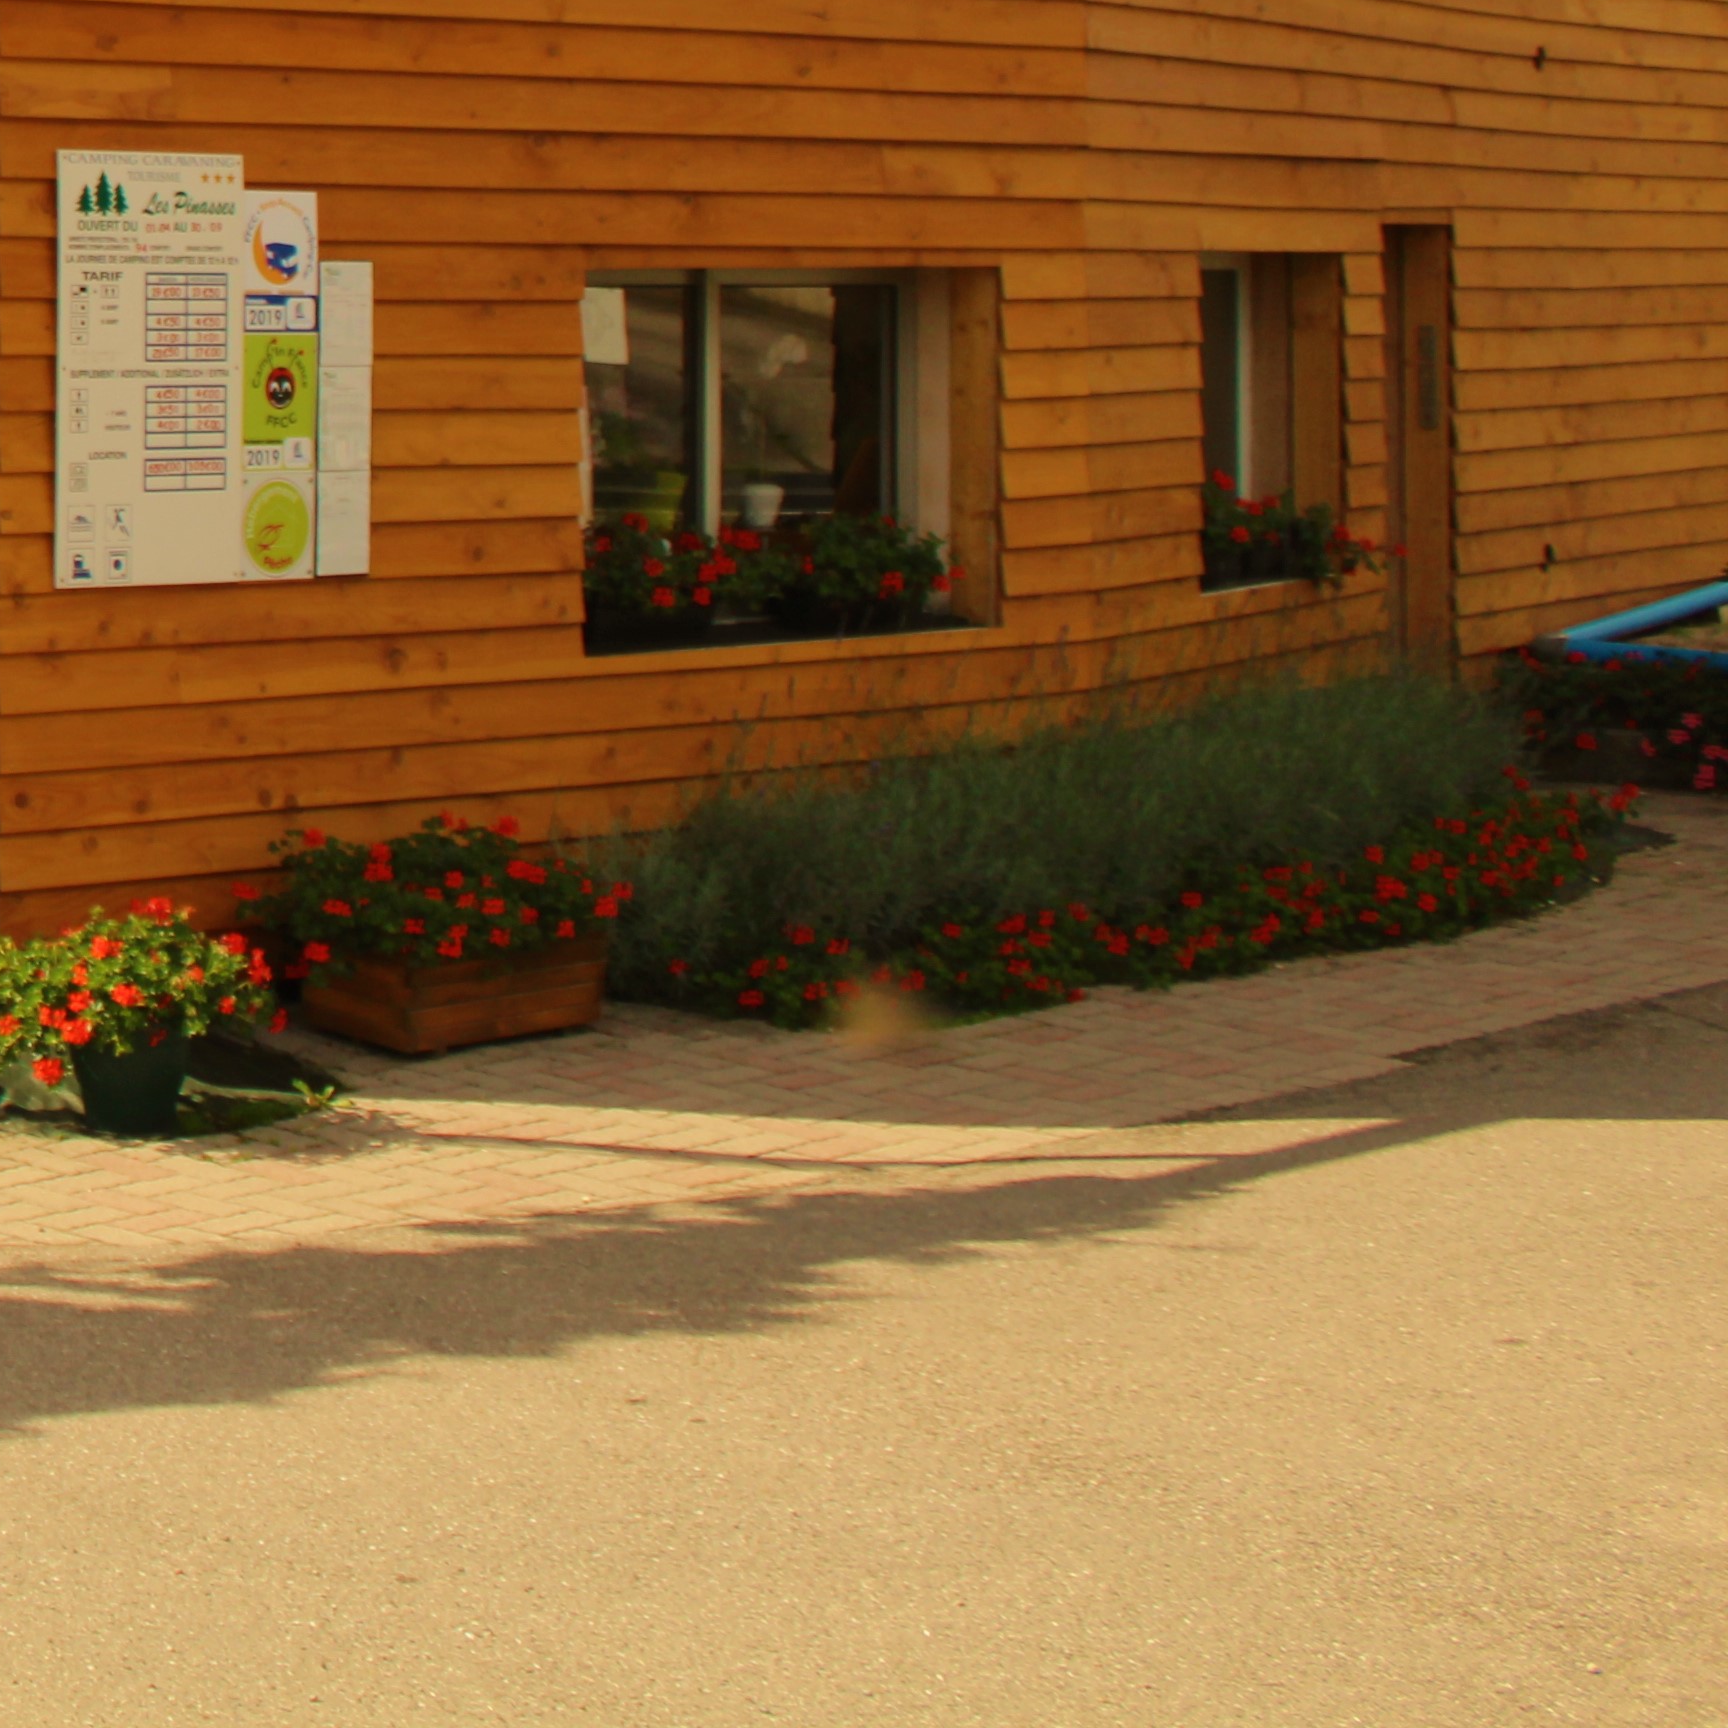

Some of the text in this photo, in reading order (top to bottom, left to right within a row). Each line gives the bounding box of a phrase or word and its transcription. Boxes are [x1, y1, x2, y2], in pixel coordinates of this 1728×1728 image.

[67, 153, 236, 168] CAMPING CARAVANING
[127, 171, 182, 182] TOURISME
[142, 191, 170, 216] Les
[174, 190, 237, 216] Pinasses
[77, 220, 120, 232] OUVERT
[122, 221, 139, 232] DU
[173, 221, 188, 233] AU
[82, 271, 123, 281] TARIF
[248, 309, 282, 325] 2019
[266, 412, 297, 428] FFCC
[88, 451, 128, 460] LOCATION
[247, 449, 280, 466] 2019
